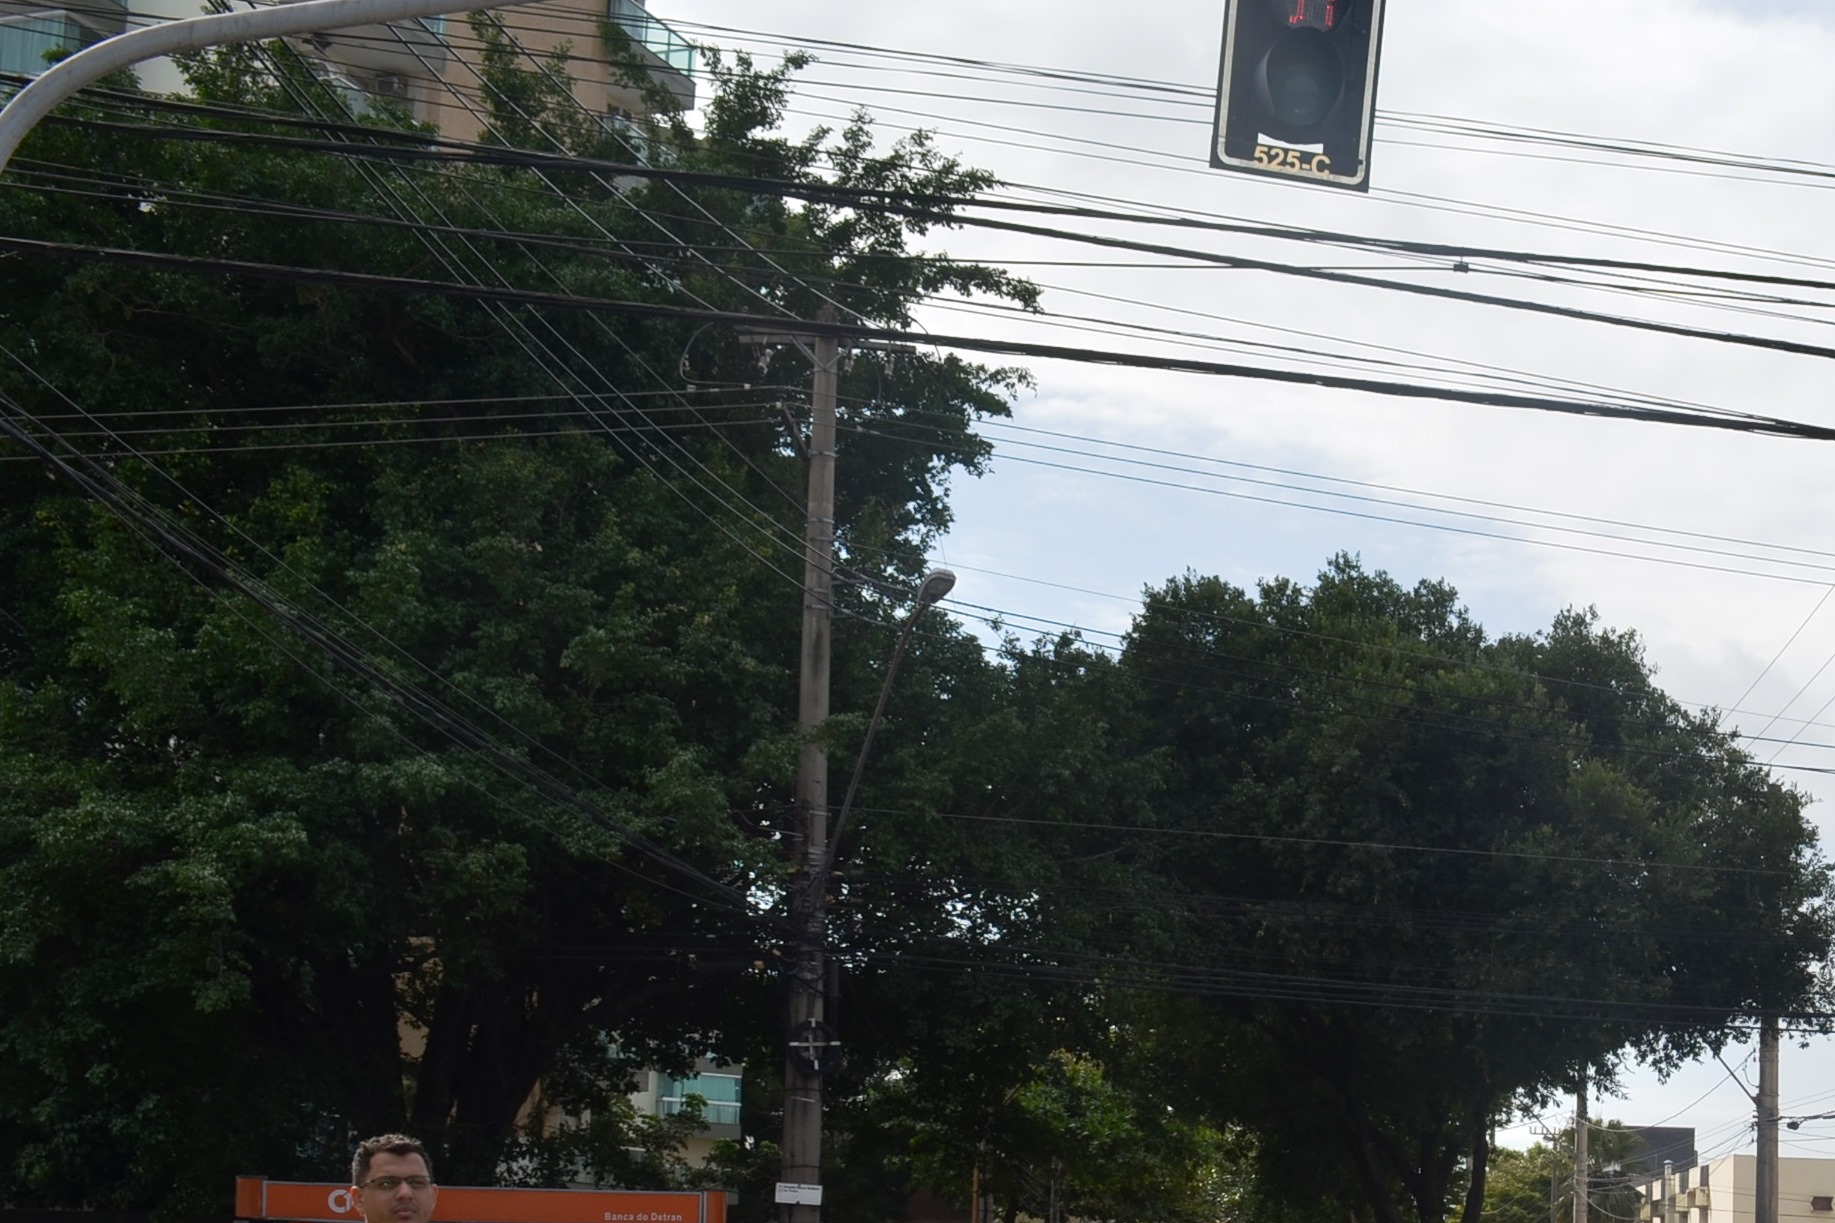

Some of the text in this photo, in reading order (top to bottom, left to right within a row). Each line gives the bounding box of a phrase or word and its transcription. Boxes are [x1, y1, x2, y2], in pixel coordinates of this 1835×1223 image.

[1253, 145, 1331, 177] 525-C
[604, 1212, 682, 1222] Banca do Detran
